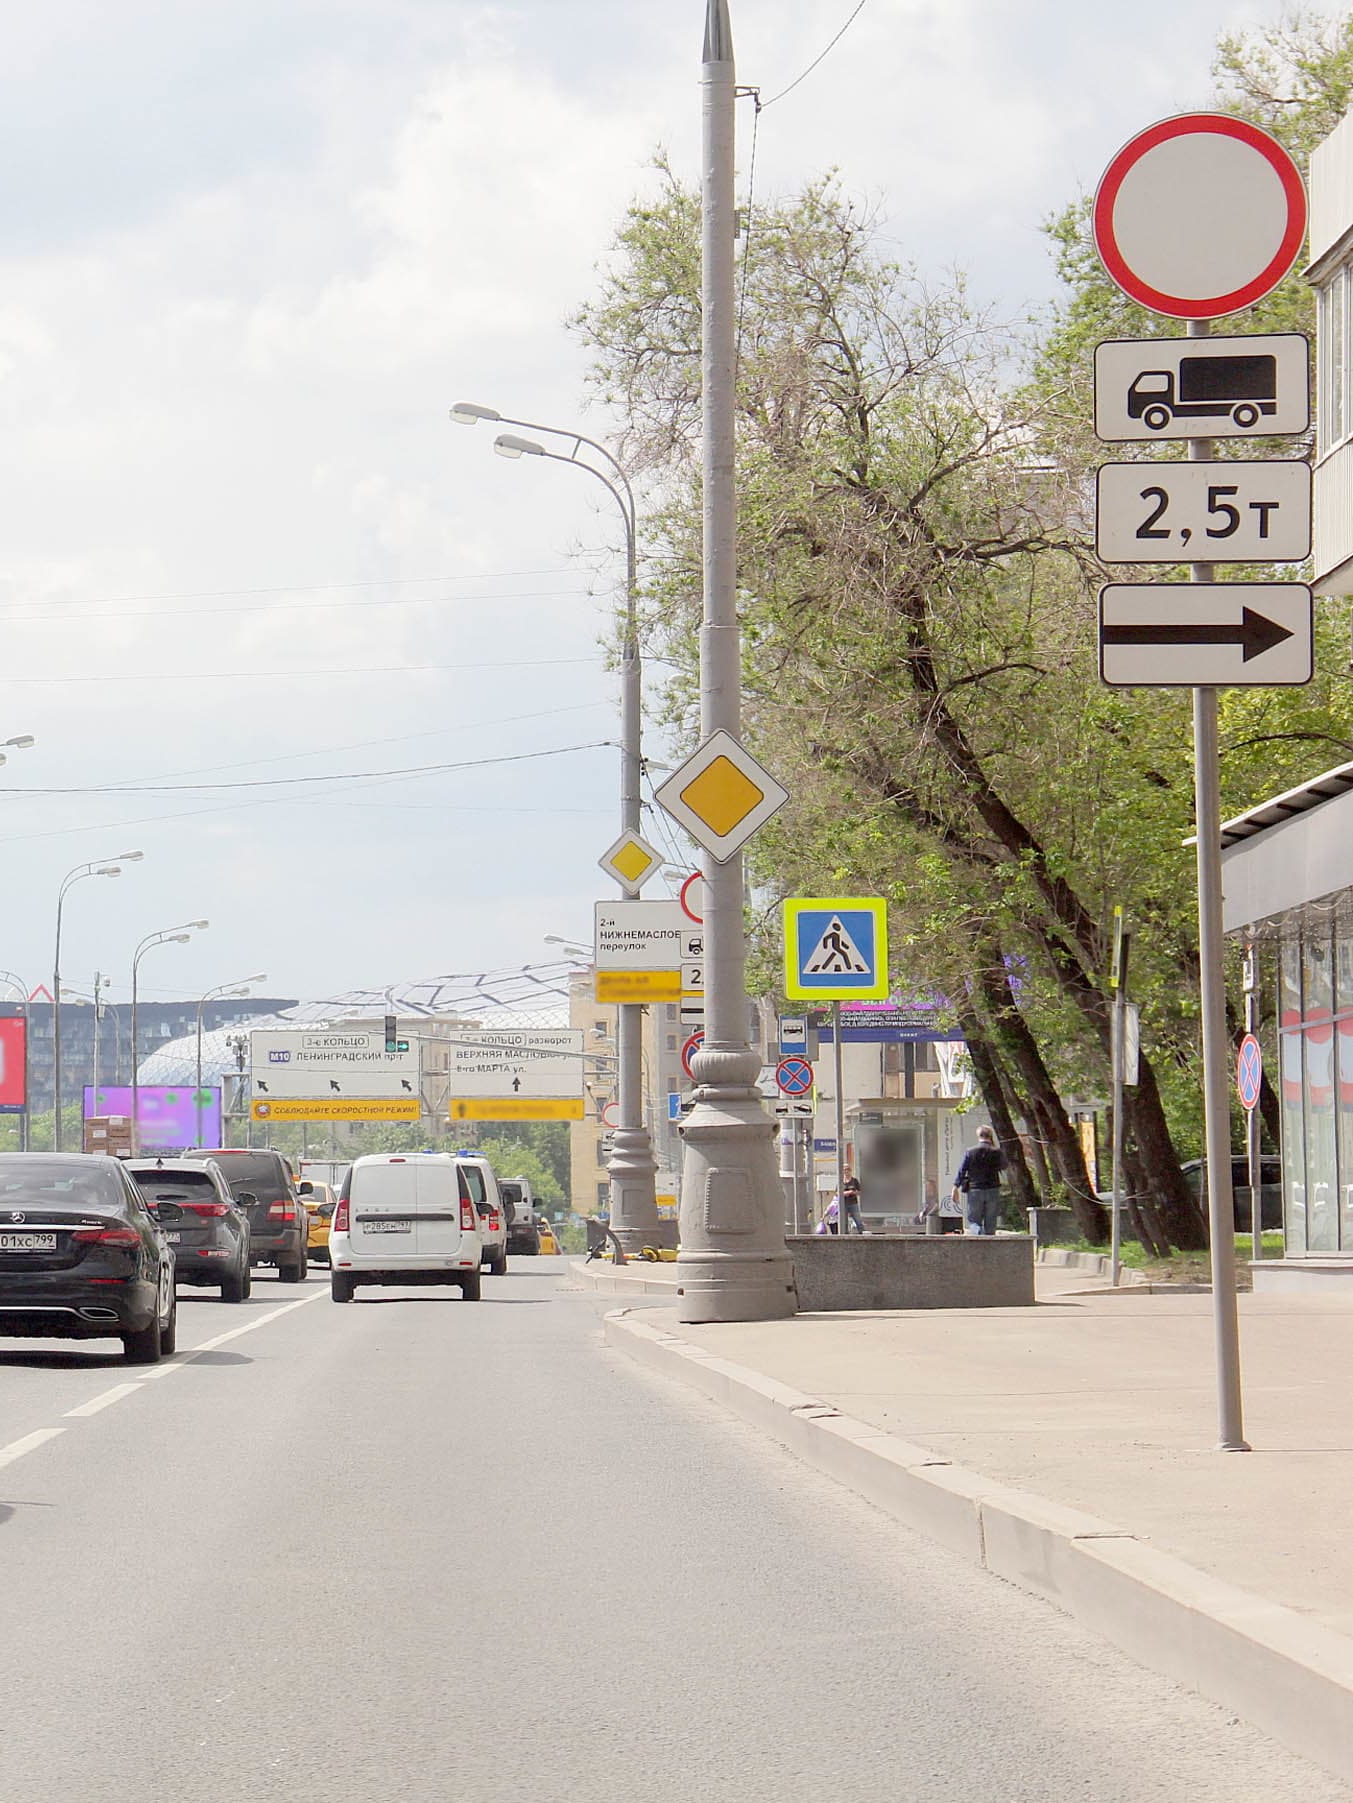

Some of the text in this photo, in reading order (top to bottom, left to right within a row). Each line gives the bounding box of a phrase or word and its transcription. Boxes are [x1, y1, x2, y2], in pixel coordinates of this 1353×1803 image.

[1135, 484, 1280, 548] 2,5т
[600, 942, 647, 952] переулок
[323, 1037, 365, 1048] КОЛЬЦО
[480, 1036, 522, 1046] КОЛЬЦО
[456, 1050, 503, 1059] ВЕРХНЯЯ
[476, 1064, 511, 1073] МАРТА
[34, 1234, 54, 1245] 799
